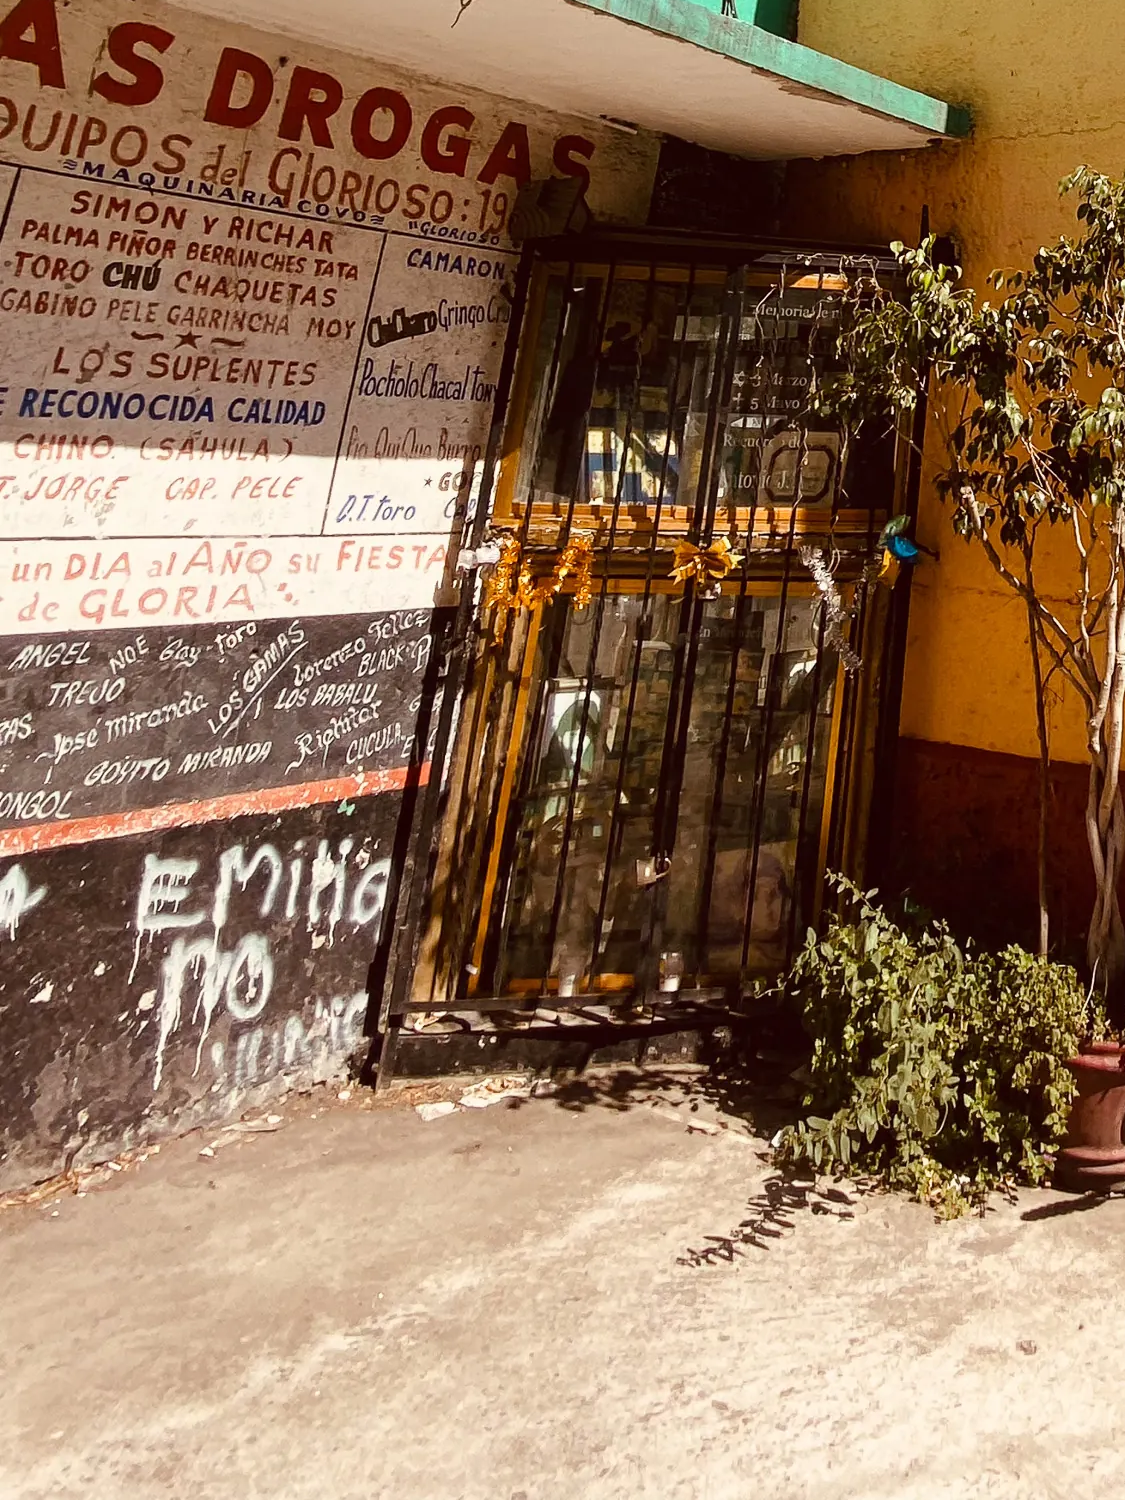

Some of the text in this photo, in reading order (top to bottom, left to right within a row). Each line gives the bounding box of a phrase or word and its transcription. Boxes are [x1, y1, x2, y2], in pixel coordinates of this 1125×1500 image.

[203, 47, 596, 198] DROGAS
[201, 145, 252, 188] del
[82, 161, 366, 222] MAQUINARIA COVO
[70, 190, 333, 254] SIMON Y RICHAR
[21, 219, 99, 248] PALMA
[186, 241, 307, 274] BERRINCHES
[314, 259, 358, 281] TATA
[407, 248, 506, 280] CAMARON
[14, 251, 91, 283] TORO
[174, 270, 338, 308] CHAQUETAS
[0, 288, 356, 340] GABINO PELE GARRINCHA MOY
[52, 346, 317, 389] LOS SUPLENTES
[19, 388, 214, 423] RECONOCIDA
[227, 397, 326, 426] CALIDAD
[24, 476, 129, 500] JORGE
[232, 476, 304, 499] PELE
[12, 562, 51, 581] un
[64, 551, 131, 581] DIA
[182, 541, 272, 575] AÑO
[18, 583, 254, 624] de GLORIA
[8, 641, 91, 670] ANGEL
[109, 635, 150, 674] NOE
[48, 677, 126, 707] TREJO
[177, 741, 273, 774] MIRANDA
